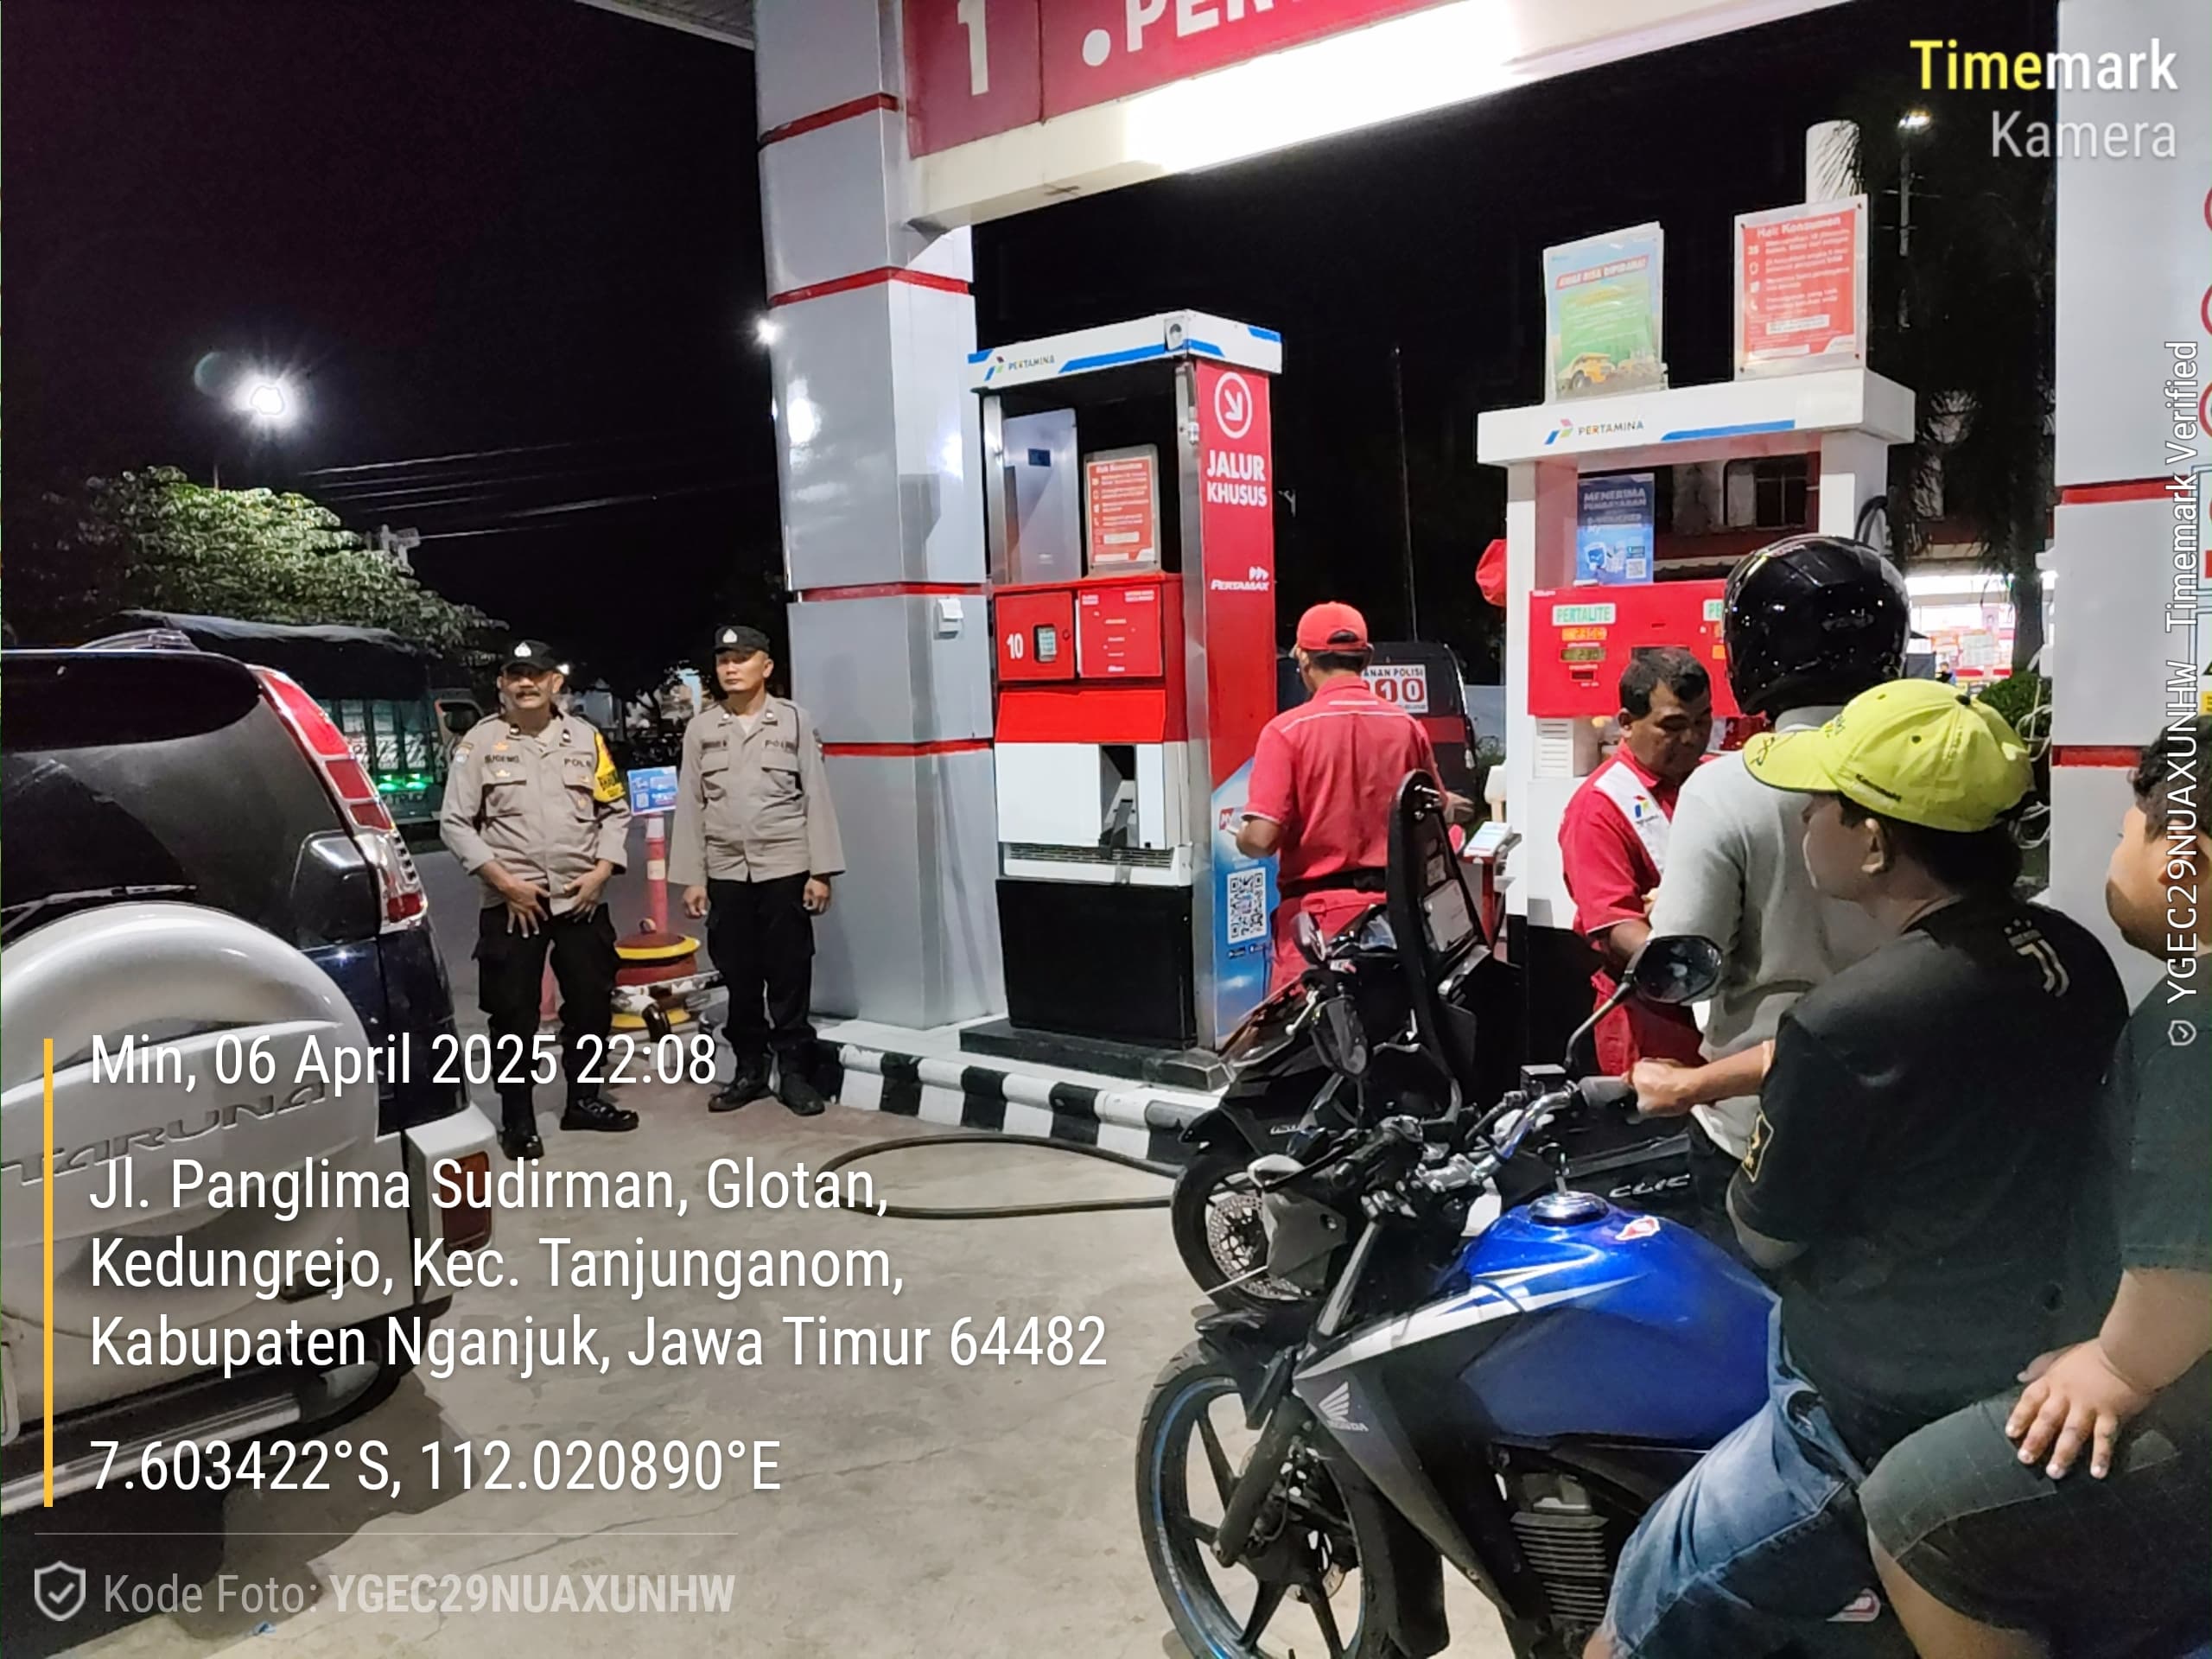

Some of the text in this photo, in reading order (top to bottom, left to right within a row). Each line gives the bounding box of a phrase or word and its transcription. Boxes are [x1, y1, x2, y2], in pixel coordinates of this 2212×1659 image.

[957, 0, 988, 95] 1
[1578, 419, 1644, 435] PERTAMINA
[1206, 448, 1267, 482] JALUR
[1206, 480, 1268, 508] KHUSUS
[1556, 606, 1612, 623] PERTALITE
[1006, 632, 1024, 660] 10
[1393, 668, 1424, 677] POLISI
[0, 1080, 327, 1185] TARUNA
